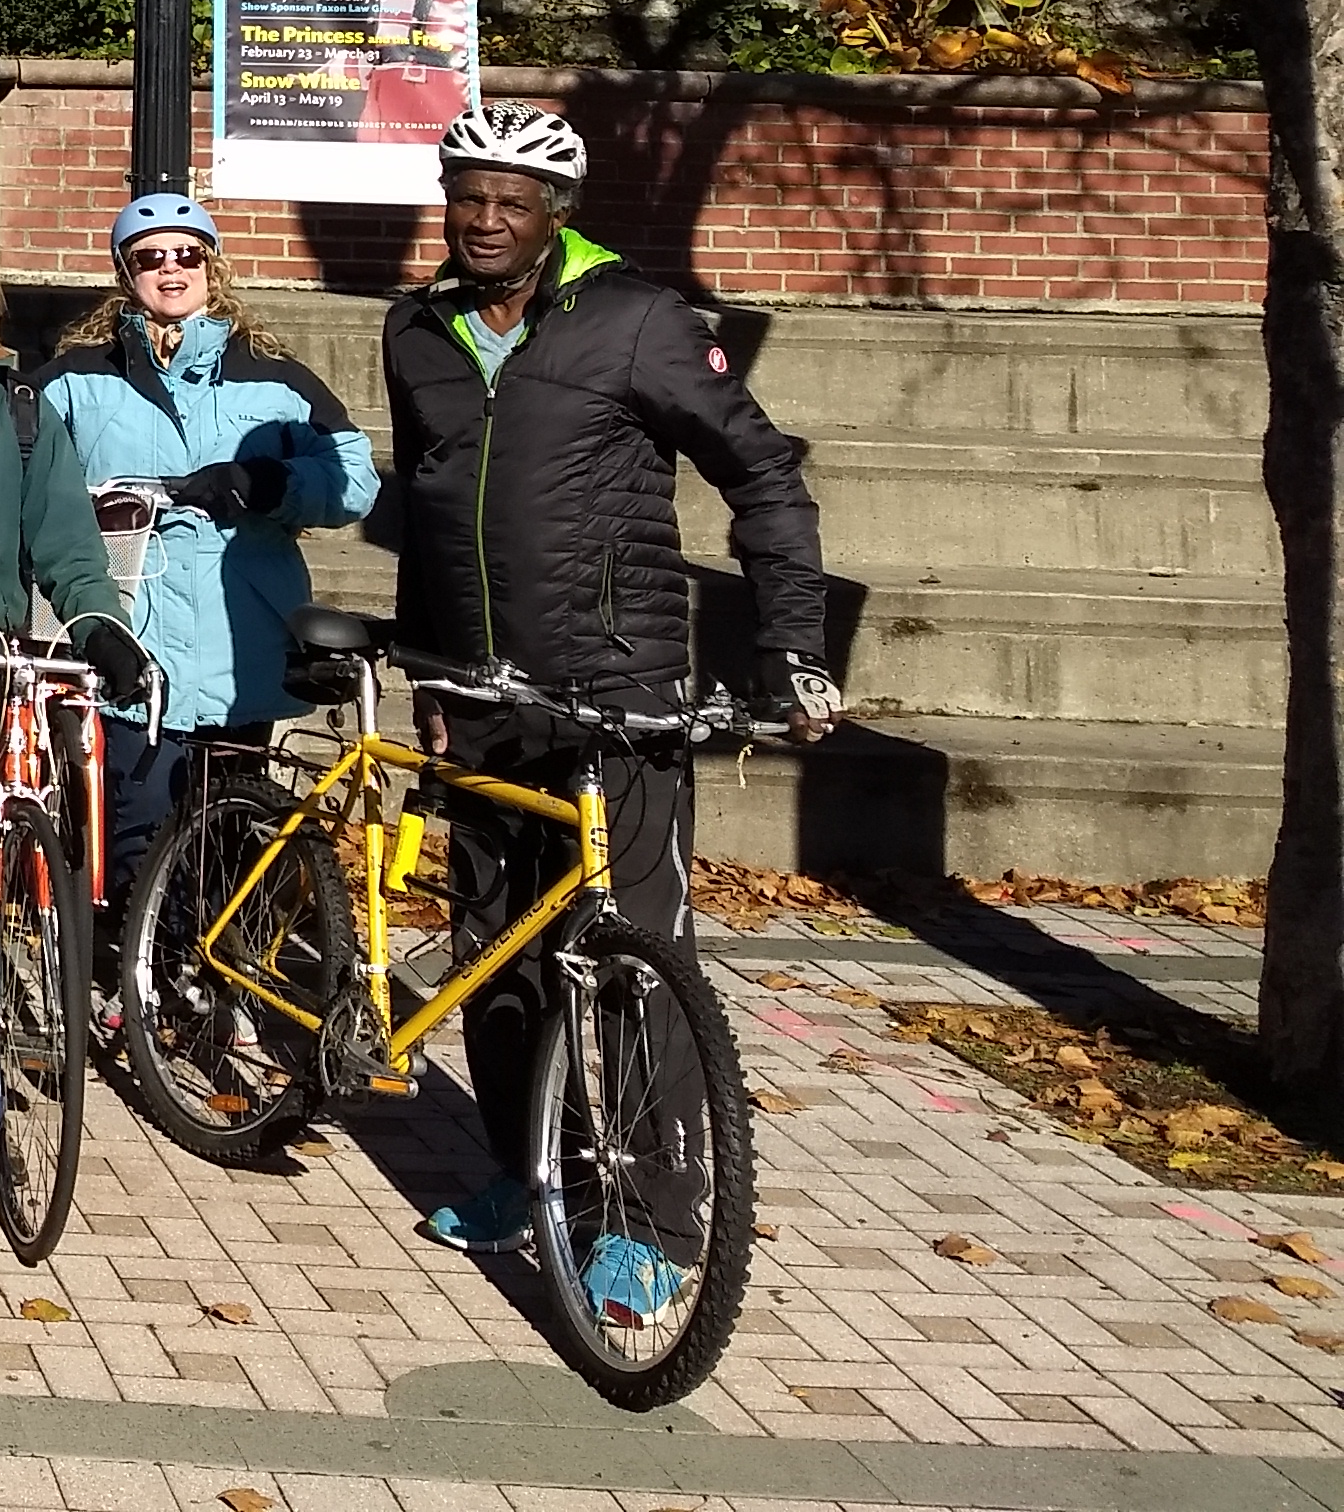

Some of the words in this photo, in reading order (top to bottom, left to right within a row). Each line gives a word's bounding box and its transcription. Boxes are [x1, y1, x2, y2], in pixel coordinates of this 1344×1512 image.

[241, 2, 268, 12] Show
[316, 3, 347, 13] Faxon
[348, 4, 369, 13] Law
[240, 25, 280, 42] The
[283, 26, 365, 44] Princess
[412, 29, 454, 52] Frog
[240, 46, 296, 59] February
[298, 49, 312, 59] 23
[325, 47, 364, 59] March
[367, 50, 380, 61] 31
[240, 72, 294, 89] Snow
[298, 73, 361, 91] White
[240, 92, 271, 105] April
[273, 95, 287, 105] 13
[299, 93, 326, 106] May
[329, 96, 343, 105] 19
[347, 120, 386, 129] SUBJECT
[389, 121, 402, 129] TO
[405, 122, 443, 130] CHANGE
